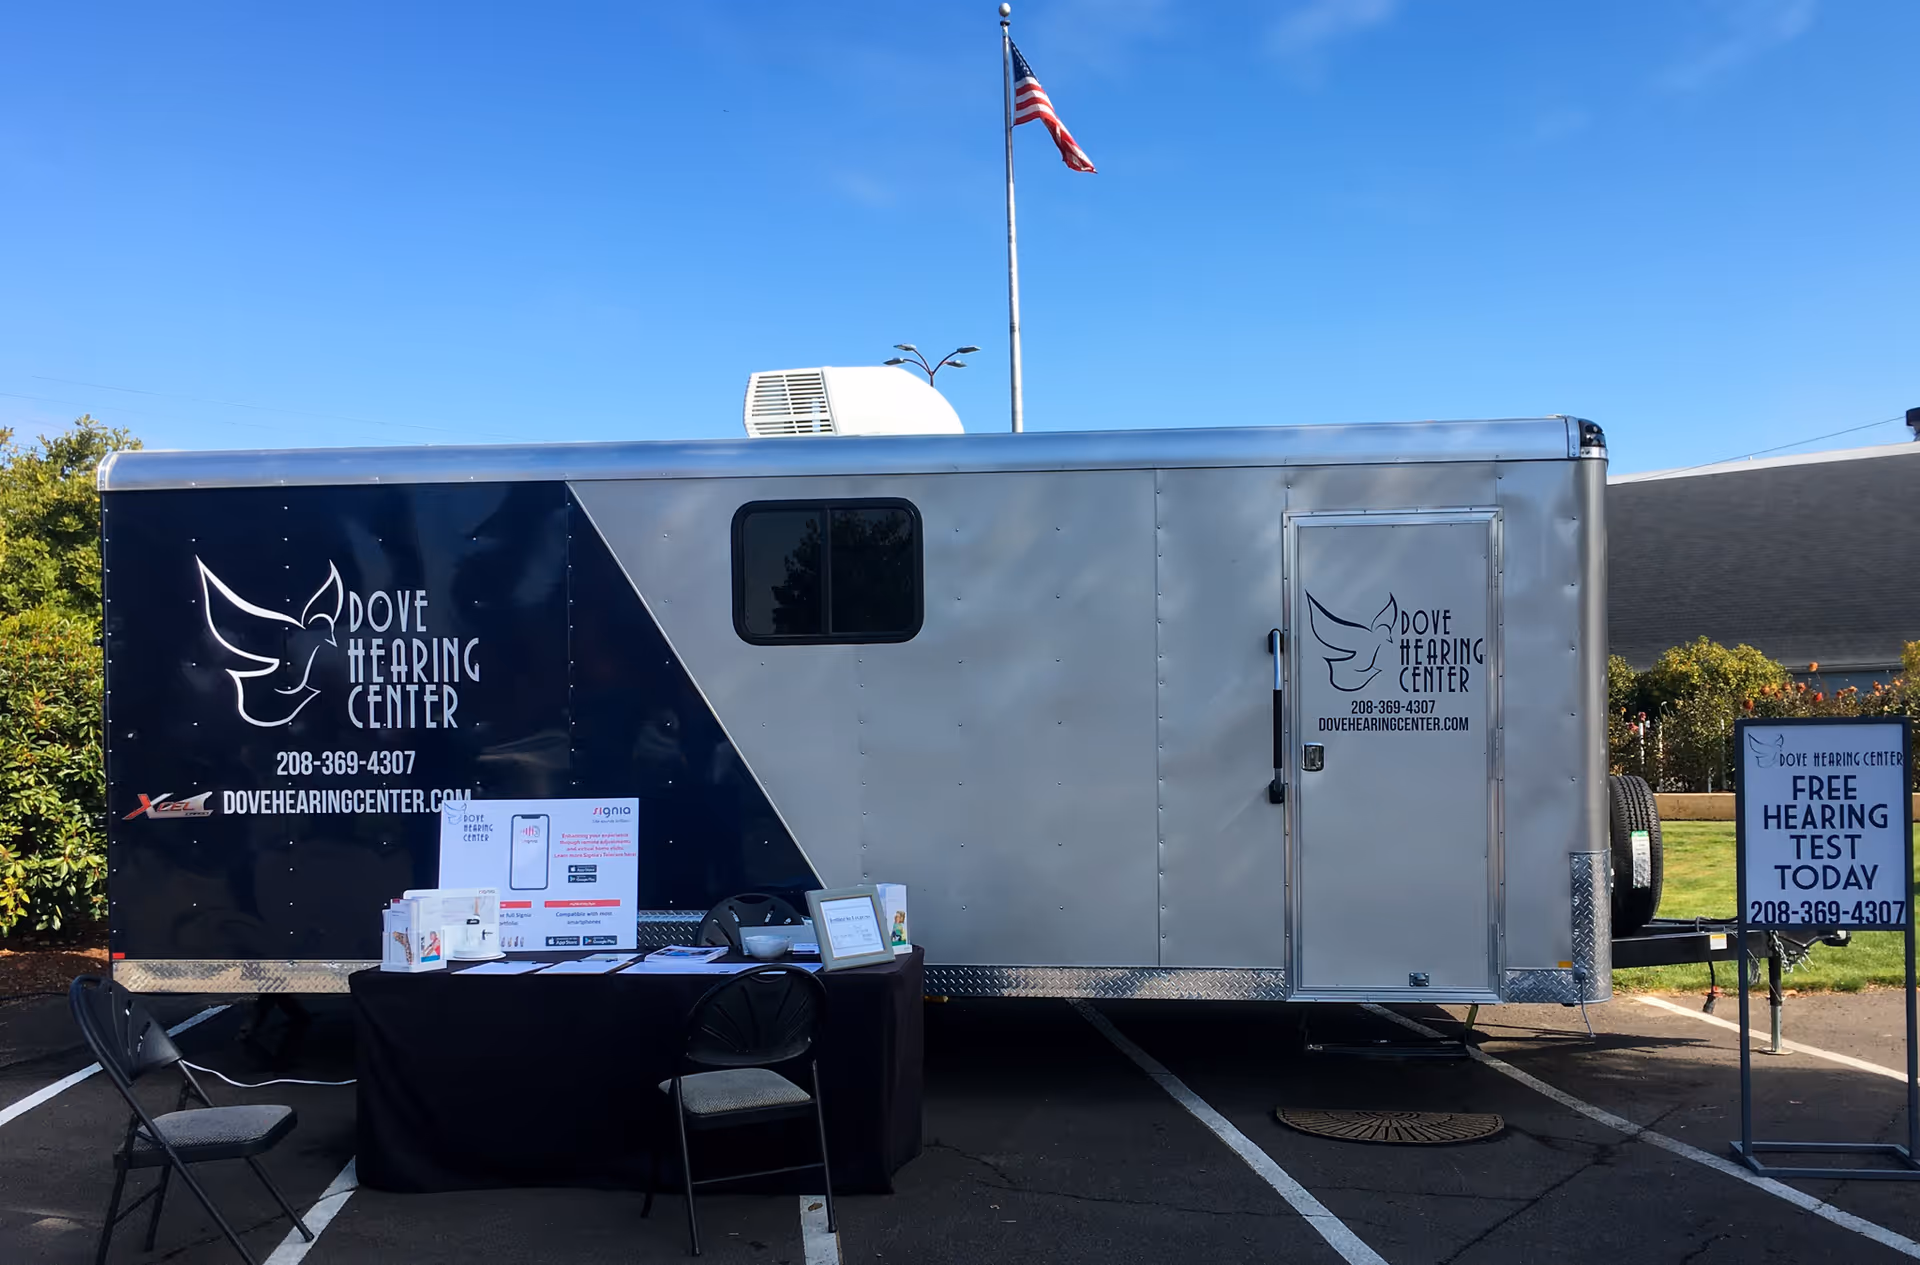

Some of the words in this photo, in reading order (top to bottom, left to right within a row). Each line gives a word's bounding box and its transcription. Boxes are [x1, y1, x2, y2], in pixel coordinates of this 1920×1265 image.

[349, 590, 428, 632] DOVE
[1401, 610, 1452, 635] DOVE
[348, 638, 480, 683] HEARING
[1400, 638, 1484, 665] HEARING
[1400, 666, 1470, 693] CENTER
[348, 684, 459, 729] CENTER
[1351, 700, 1436, 714] 208-369-4307
[1318, 716, 1469, 731] DOVEHEARINGCENTER.COM
[276, 750, 416, 775] 208-369-4307
[1780, 753, 1807, 767] DOVE
[1814, 751, 1860, 767] HEARING
[1864, 751, 1904, 767] CENTER
[1793, 775, 1857, 800] FREE
[463, 814, 484, 823] DOVE
[593, 806, 631, 818] signia
[1764, 803, 1888, 829] HEARING
[463, 824, 493, 832] HEARING
[463, 833, 489, 842] CENTER
[1790, 834, 1862, 860] TEST
[1774, 864, 1879, 890] TODAY
[1750, 900, 1905, 924] 208-369-4307
